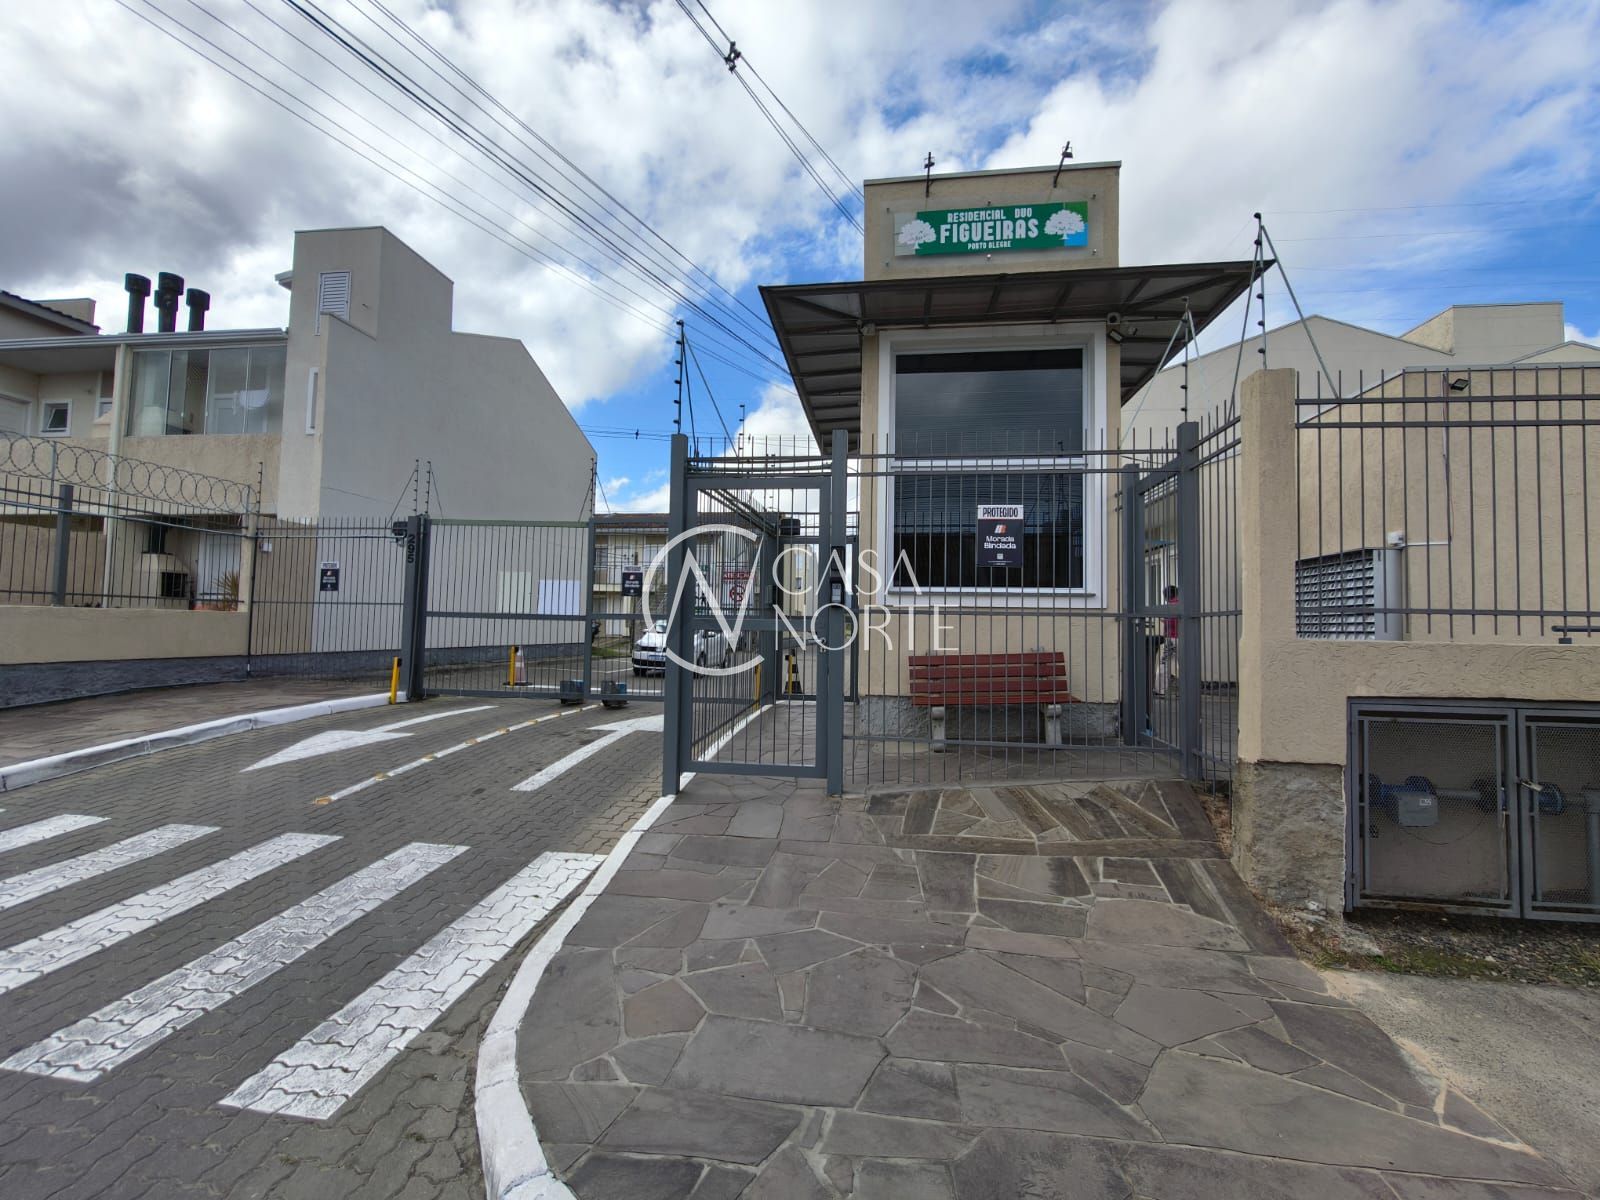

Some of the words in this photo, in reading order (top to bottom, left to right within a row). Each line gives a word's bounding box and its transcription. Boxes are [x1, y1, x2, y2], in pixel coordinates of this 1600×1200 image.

[947, 209, 1006, 223] RESIDENCIAL
[1014, 207, 1032, 218] DUO
[940, 218, 1038, 244] FIGUEIRAS
[967, 242, 987, 250] PORTO
[988, 240, 1011, 249] ALEGRE
[982, 507, 1018, 518] PROTEGIDO
[407, 534, 416, 564] 295
